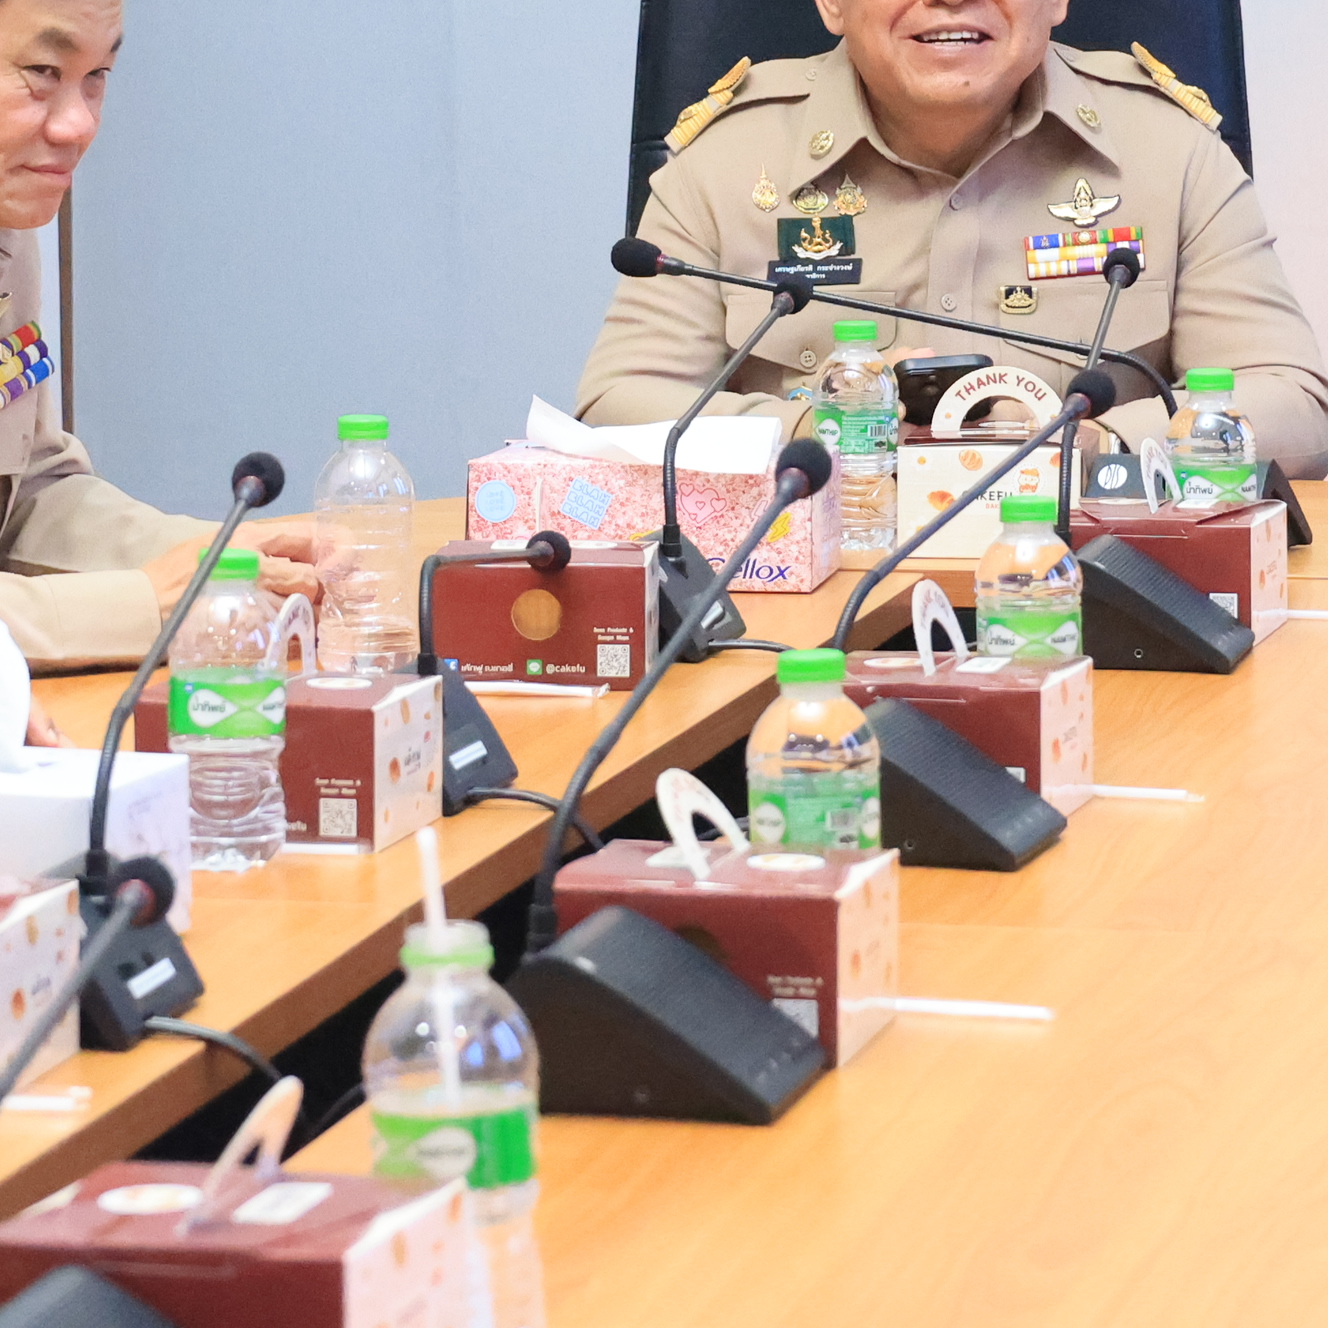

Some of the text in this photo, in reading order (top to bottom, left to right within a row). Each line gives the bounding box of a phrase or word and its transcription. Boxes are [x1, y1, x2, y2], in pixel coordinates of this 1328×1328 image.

[954, 372, 1047, 402] THANK YOU
[572, 479, 611, 505] BLAH
[1186, 481, 1213, 495] น้ำทิพย์
[562, 502, 600, 528] BLAH
[567, 490, 605, 516] BLAH
[707, 557, 792, 583] ellox
